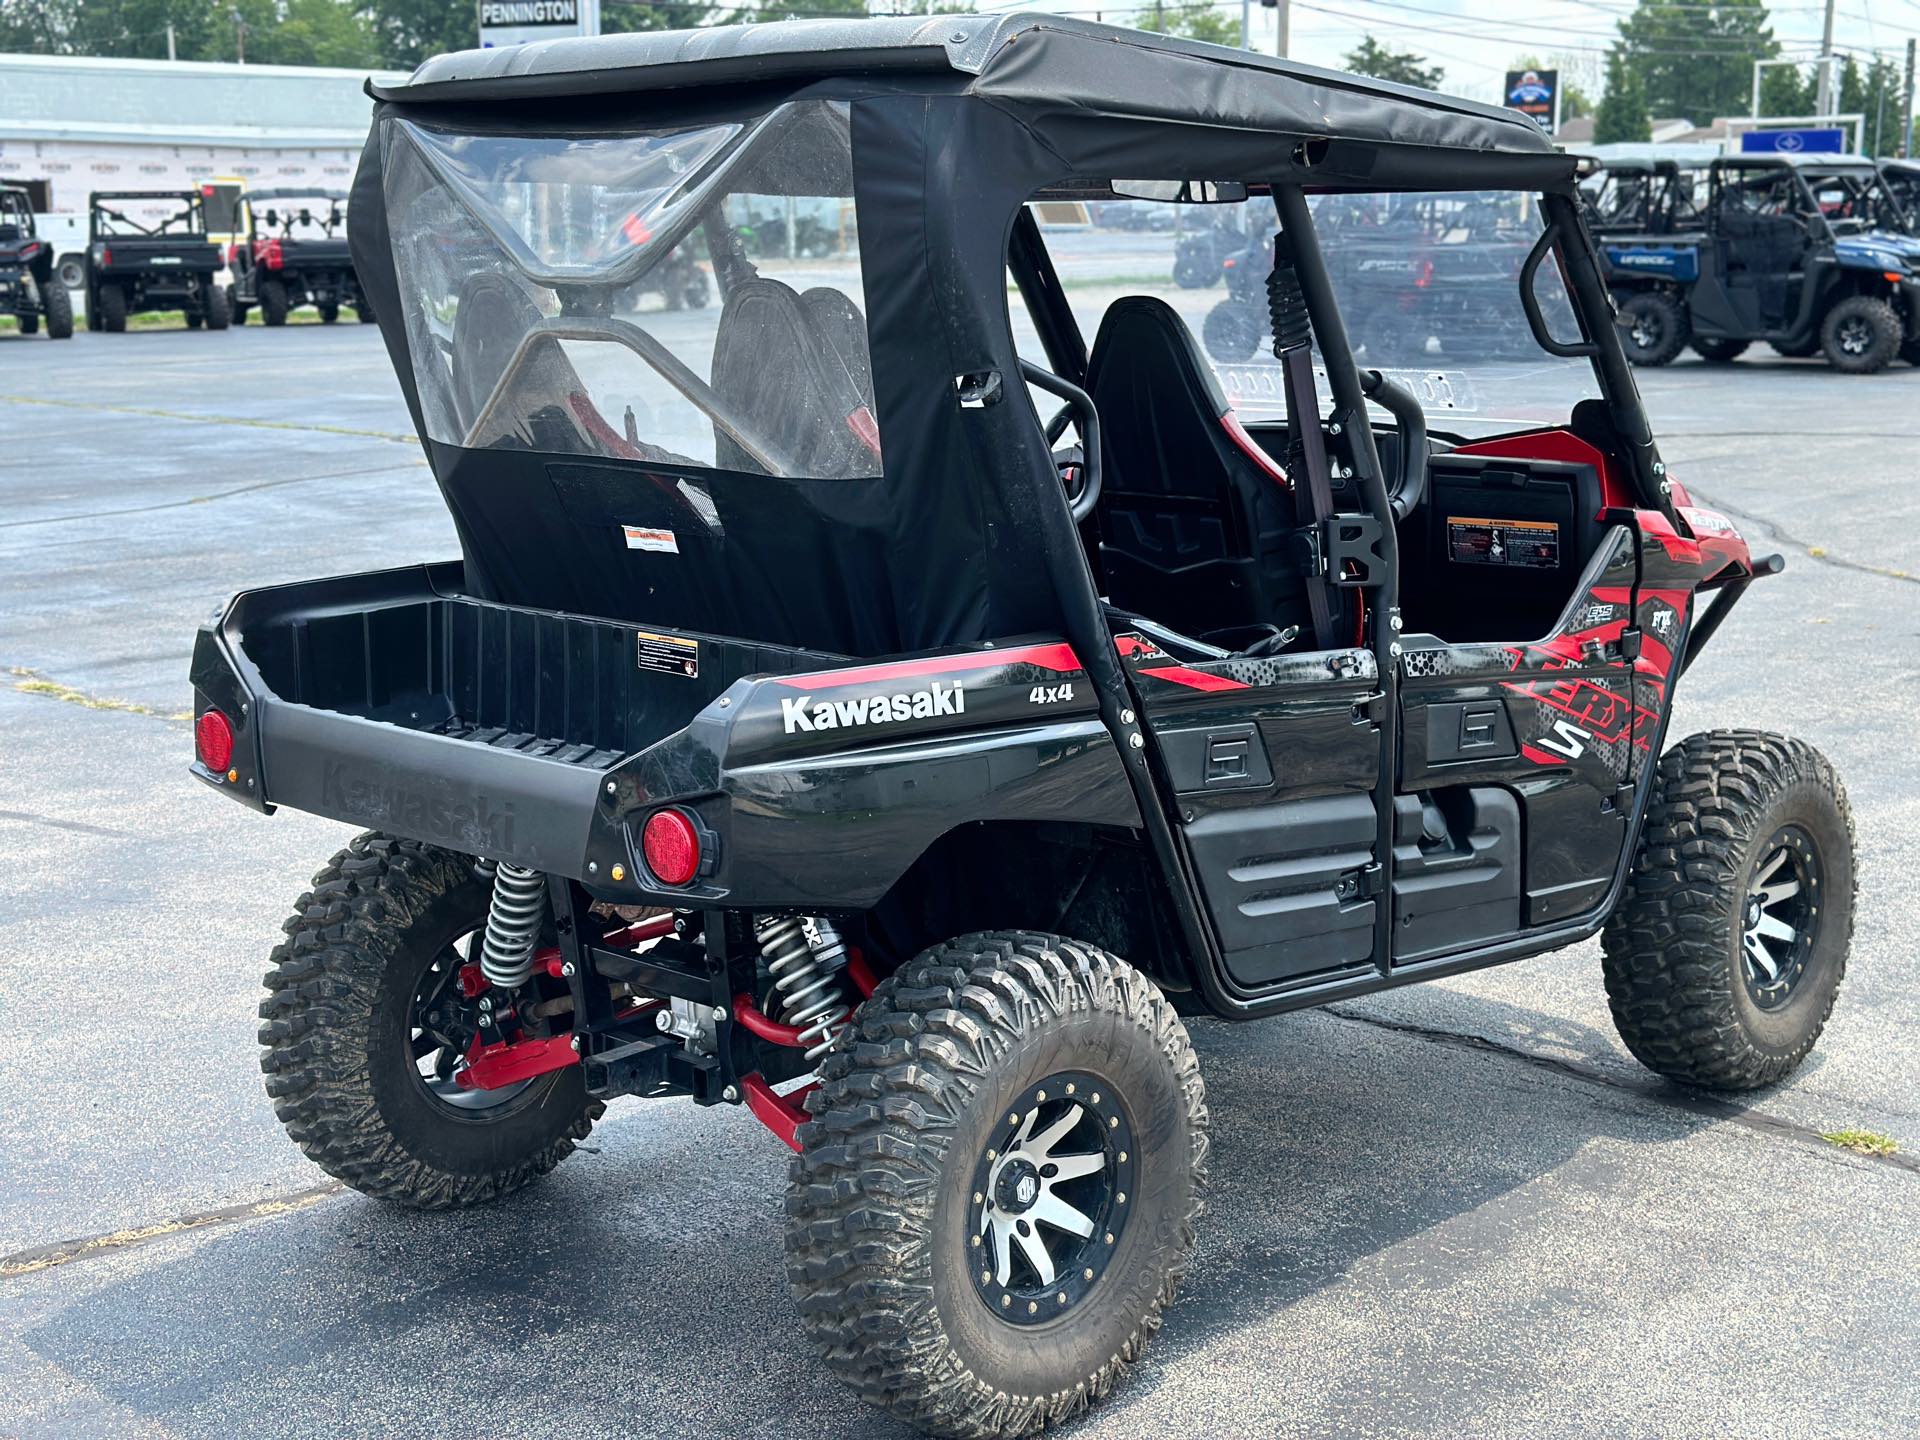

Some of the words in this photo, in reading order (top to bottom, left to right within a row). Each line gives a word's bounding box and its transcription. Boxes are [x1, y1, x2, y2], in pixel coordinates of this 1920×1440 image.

[482, 1, 575, 23] PENNINGTON
[1588, 605, 1613, 617] EPS
[780, 680, 965, 734] Kawasaki
[1029, 683, 1074, 704] 4x4
[322, 758, 515, 855] Kawasaki
